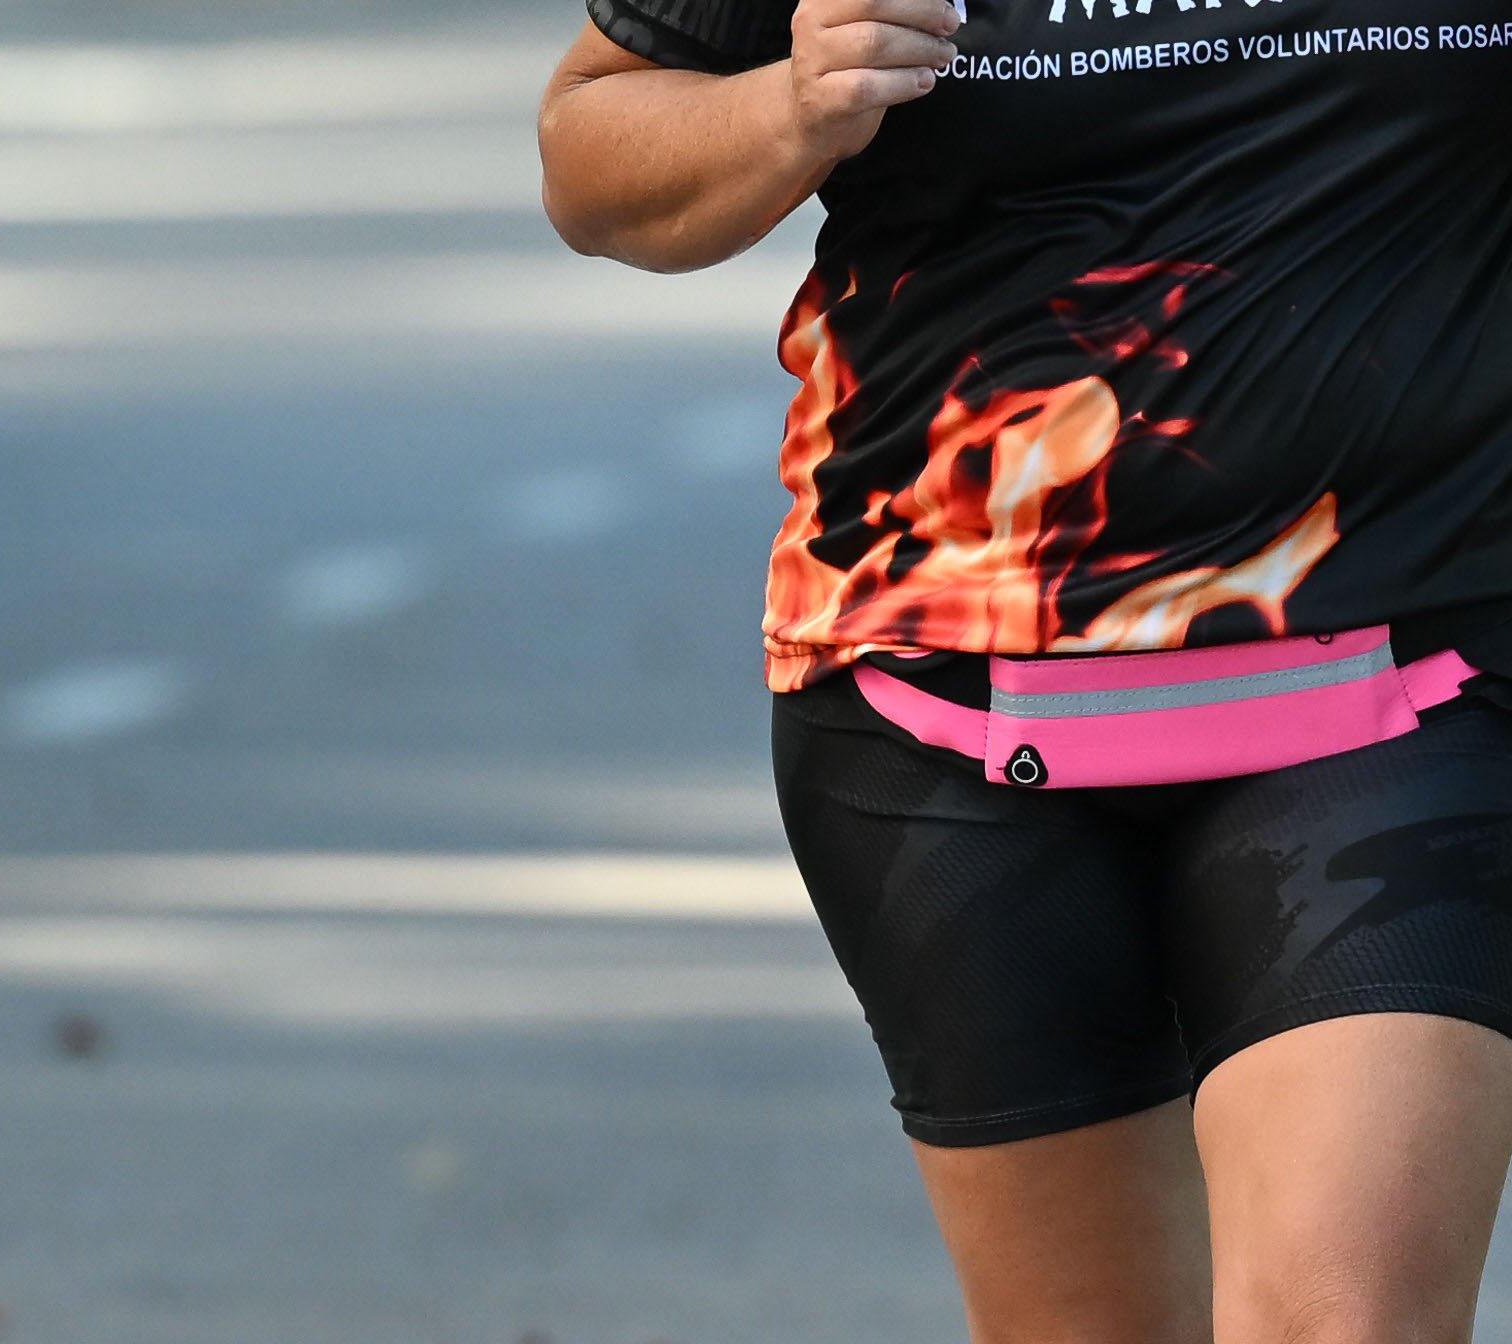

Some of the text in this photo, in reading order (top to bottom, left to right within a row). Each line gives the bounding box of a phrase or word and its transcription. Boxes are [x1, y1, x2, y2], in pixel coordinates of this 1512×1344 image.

[934, 49, 1061, 81] OCIACIÓN
[1070, 38, 1230, 77] BOMBEROS
[1238, 25, 1430, 61] VOLUNTARIOS
